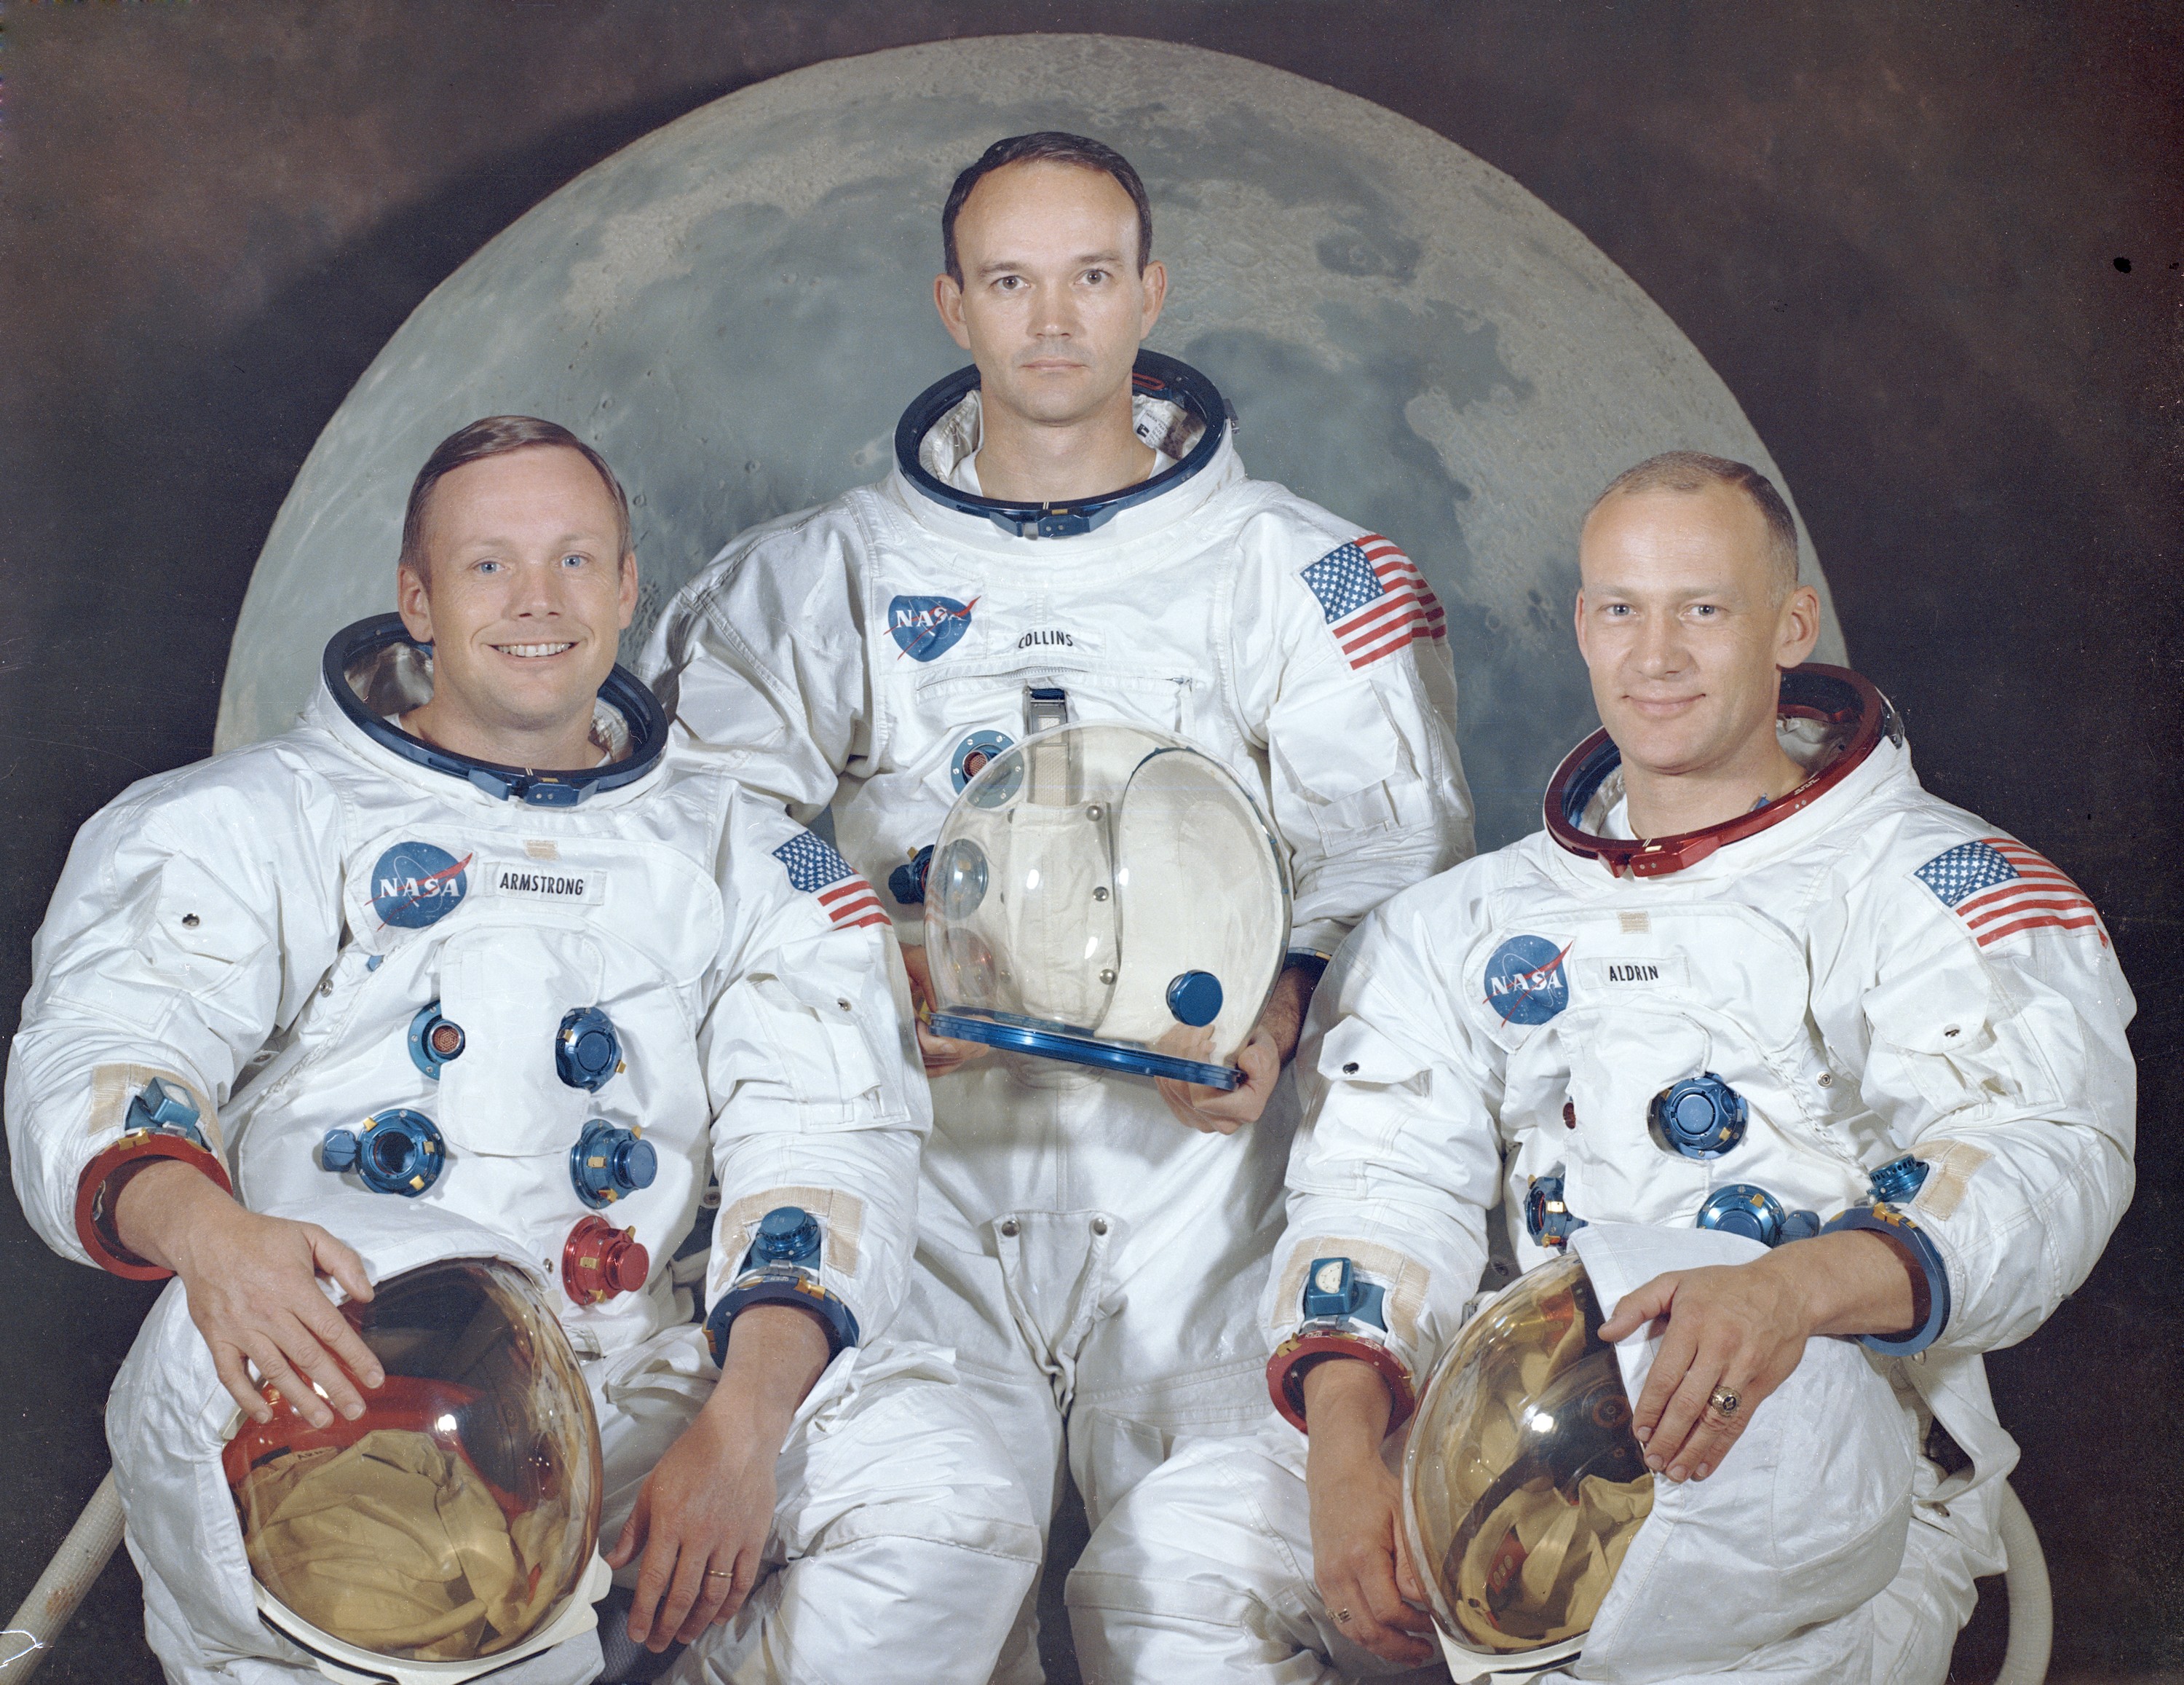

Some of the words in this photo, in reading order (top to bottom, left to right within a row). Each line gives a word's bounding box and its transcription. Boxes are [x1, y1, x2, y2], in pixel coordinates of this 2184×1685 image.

[1018, 630, 1073, 649] COLLINS
[379, 877, 461, 898] NASA
[499, 872, 584, 896] ARMSTRONG
[1490, 969, 1564, 996] NASA
[1609, 965, 1659, 982] ALDRIN
